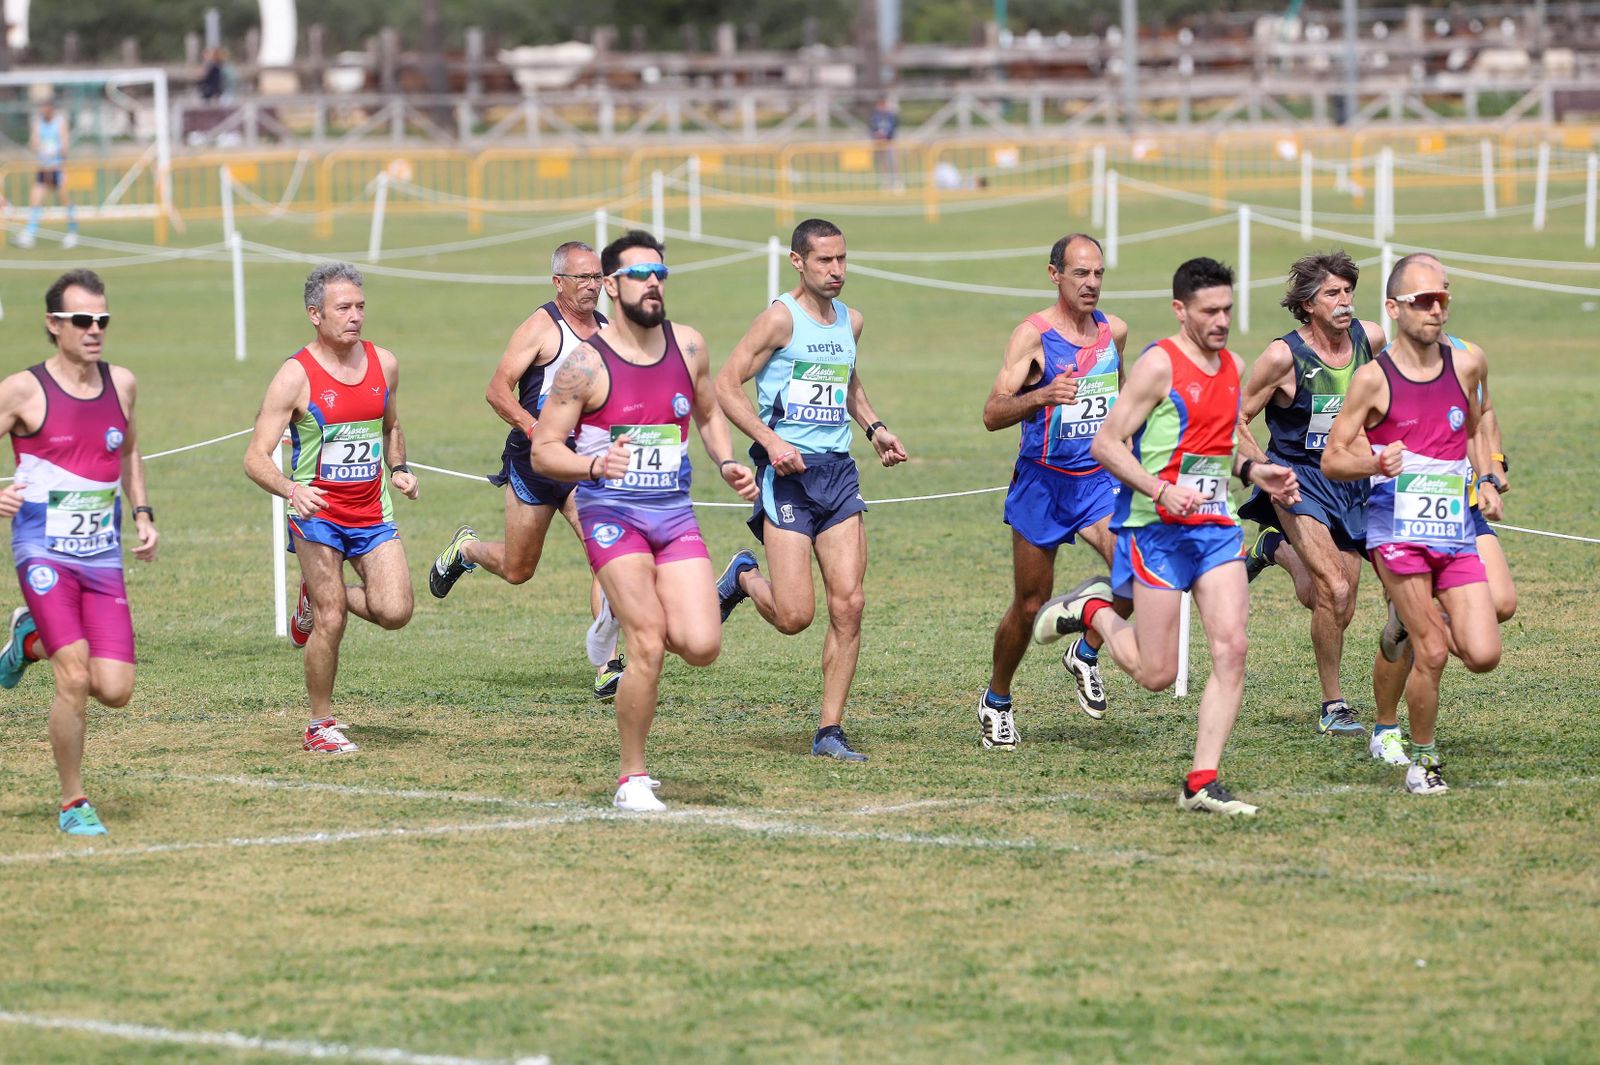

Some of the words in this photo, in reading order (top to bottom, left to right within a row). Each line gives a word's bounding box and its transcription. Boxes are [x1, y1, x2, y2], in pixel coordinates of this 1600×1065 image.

[807, 341, 844, 356] nerja
[809, 384, 833, 406] 21
[792, 406, 841, 422] Joma
[1081, 396, 1108, 420] 23
[1067, 421, 1105, 438] Jom
[342, 442, 371, 464] 22
[633, 448, 662, 471] 14
[327, 464, 378, 480] Joma
[1196, 478, 1219, 501] 13
[1417, 496, 1448, 520] 26
[70, 512, 101, 535] 25
[1401, 520, 1457, 538] Joma
